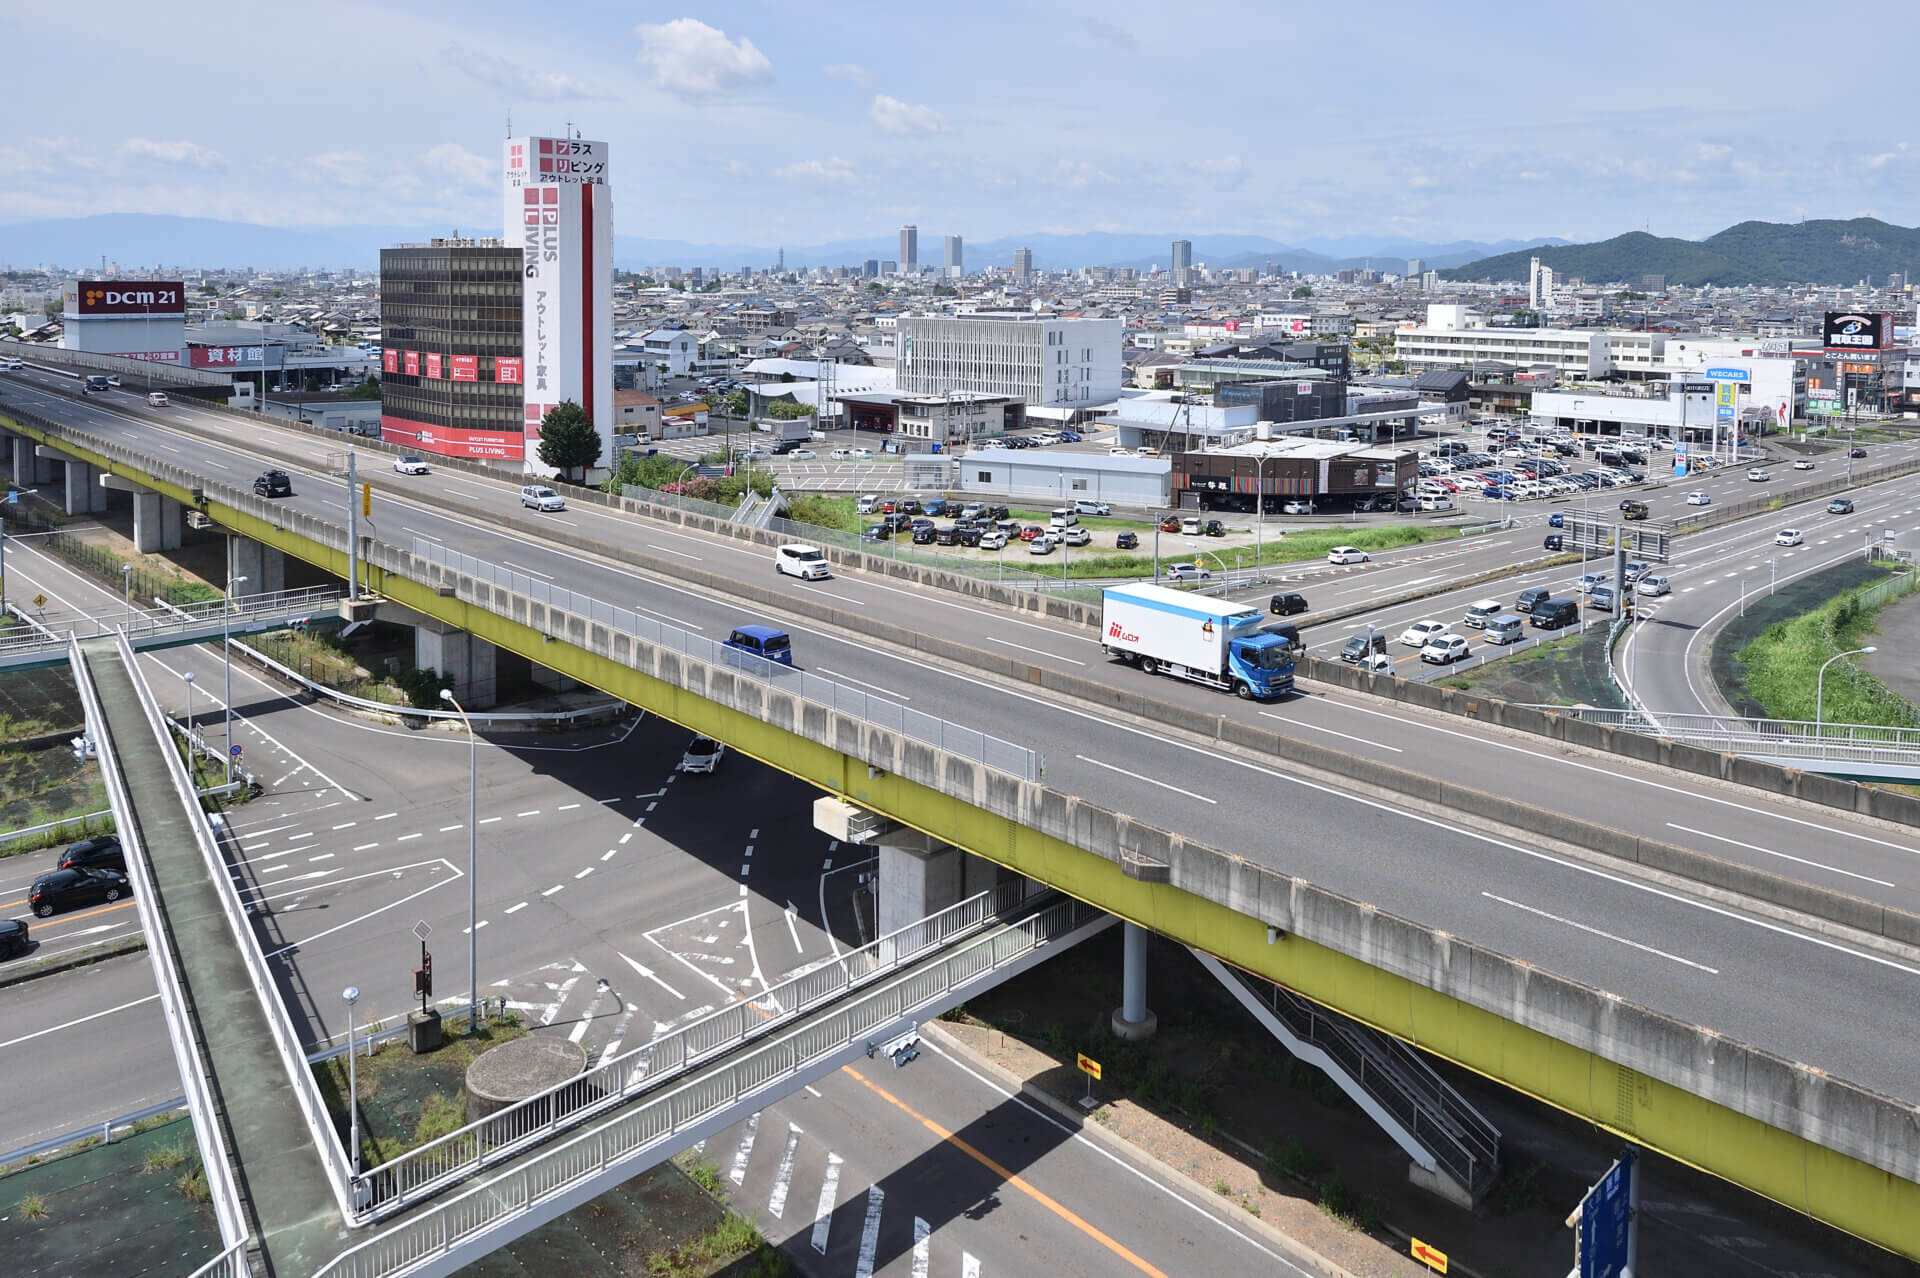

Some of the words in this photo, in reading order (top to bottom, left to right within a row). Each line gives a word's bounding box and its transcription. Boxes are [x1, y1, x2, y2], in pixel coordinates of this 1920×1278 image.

[559, 160, 605, 174] リビング
[540, 174, 603, 185] アウトレット家具
[543, 209, 558, 262] PLUS
[524, 209, 540, 278] LIVING
[158, 290, 176, 304] 21
[536, 290, 547, 391] アウトレット家具
[207, 347, 264, 362] 資材館
[1824, 353, 1878, 362] とことん買います
[485, 447, 505, 455] LIVING
[1121, 632, 1139, 644] ムロオ
